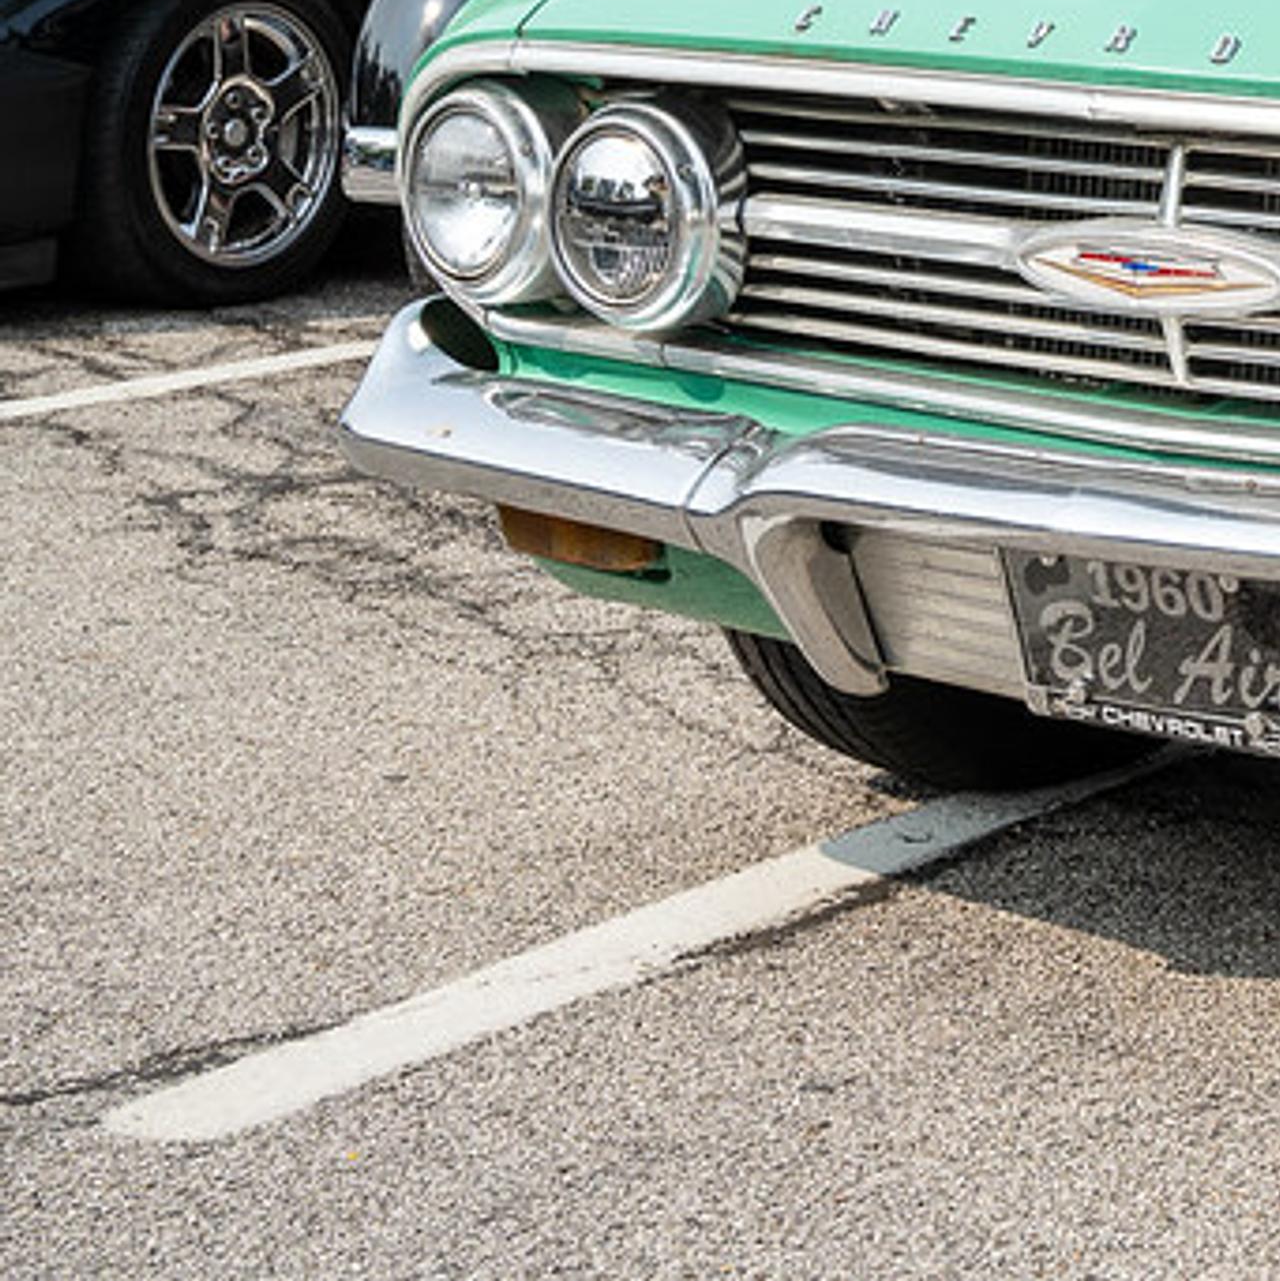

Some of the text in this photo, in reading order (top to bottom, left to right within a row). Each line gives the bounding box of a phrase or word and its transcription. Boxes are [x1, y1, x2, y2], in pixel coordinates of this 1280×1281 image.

[1087, 562, 1227, 620] 1960
[1039, 599, 1152, 694] Bel
[1102, 706, 1244, 746] CHEVROLET
